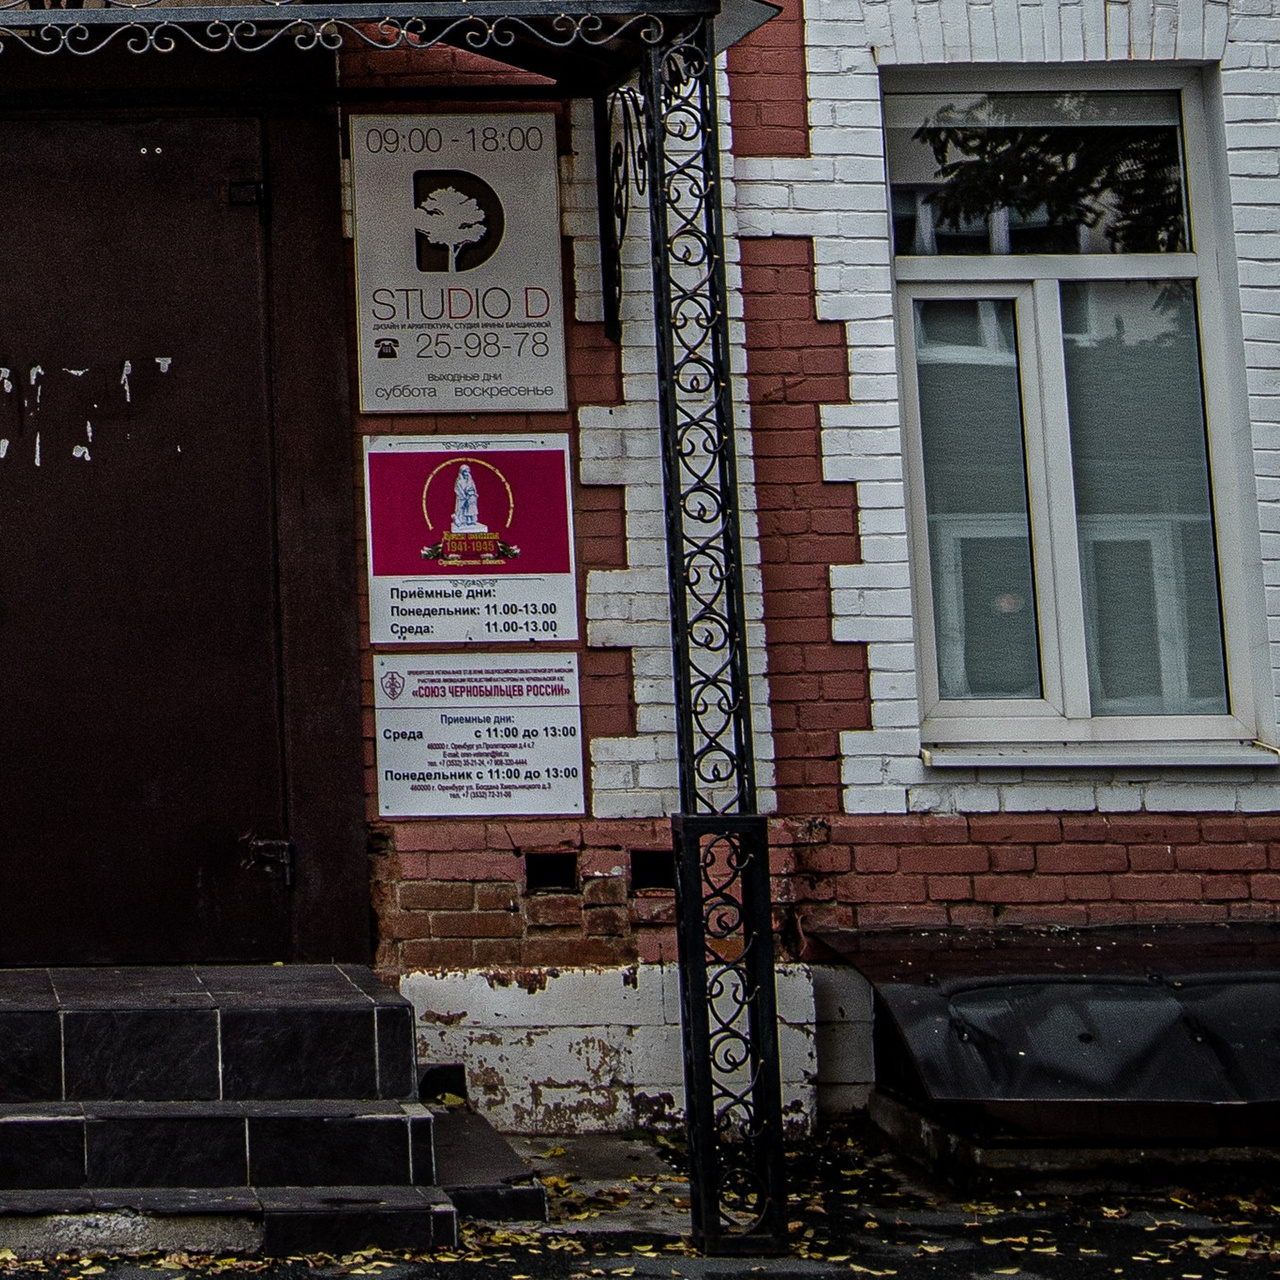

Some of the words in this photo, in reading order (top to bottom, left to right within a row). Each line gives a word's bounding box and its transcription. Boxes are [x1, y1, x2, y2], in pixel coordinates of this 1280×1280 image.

[366, 127, 443, 153] 09:00
[466, 126, 543, 152] 18:00
[371, 287, 512, 321] STUDIO
[523, 286, 551, 319] D
[416, 332, 550, 359] 25-98-78
[427, 373, 480, 382] выходные
[481, 373, 503, 383] дни
[374, 384, 437, 400] суббота
[454, 385, 554, 399] воскресенье
[446, 541, 495, 552] 1941-1945
[390, 587, 463, 601] Приёмные
[466, 588, 497, 600] дни:
[390, 605, 480, 618] Понедельник:
[484, 602, 557, 616] 11.00-13.00
[390, 622, 434, 635] Среда:
[484, 620, 558, 633] 11.00-13.00
[412, 685, 446, 698] «СОЮЗ
[448, 684, 524, 698] ЧЕРНОБЫЛЬЦЕВ
[526, 683, 571, 697] РОССИИ»
[440, 714, 492, 725] Приемные
[493, 715, 515, 724] дни:
[383, 728, 424, 742] Среда
[474, 729, 482, 738] с
[485, 726, 519, 738] 11:00
[522, 728, 539, 739] до
[542, 725, 577, 737] 13:00
[384, 770, 472, 782] Понедельник
[476, 771, 483, 780] с
[487, 768, 520, 780] 11:00
[524, 770, 541, 780] до
[544, 767, 578, 779] 13:00
